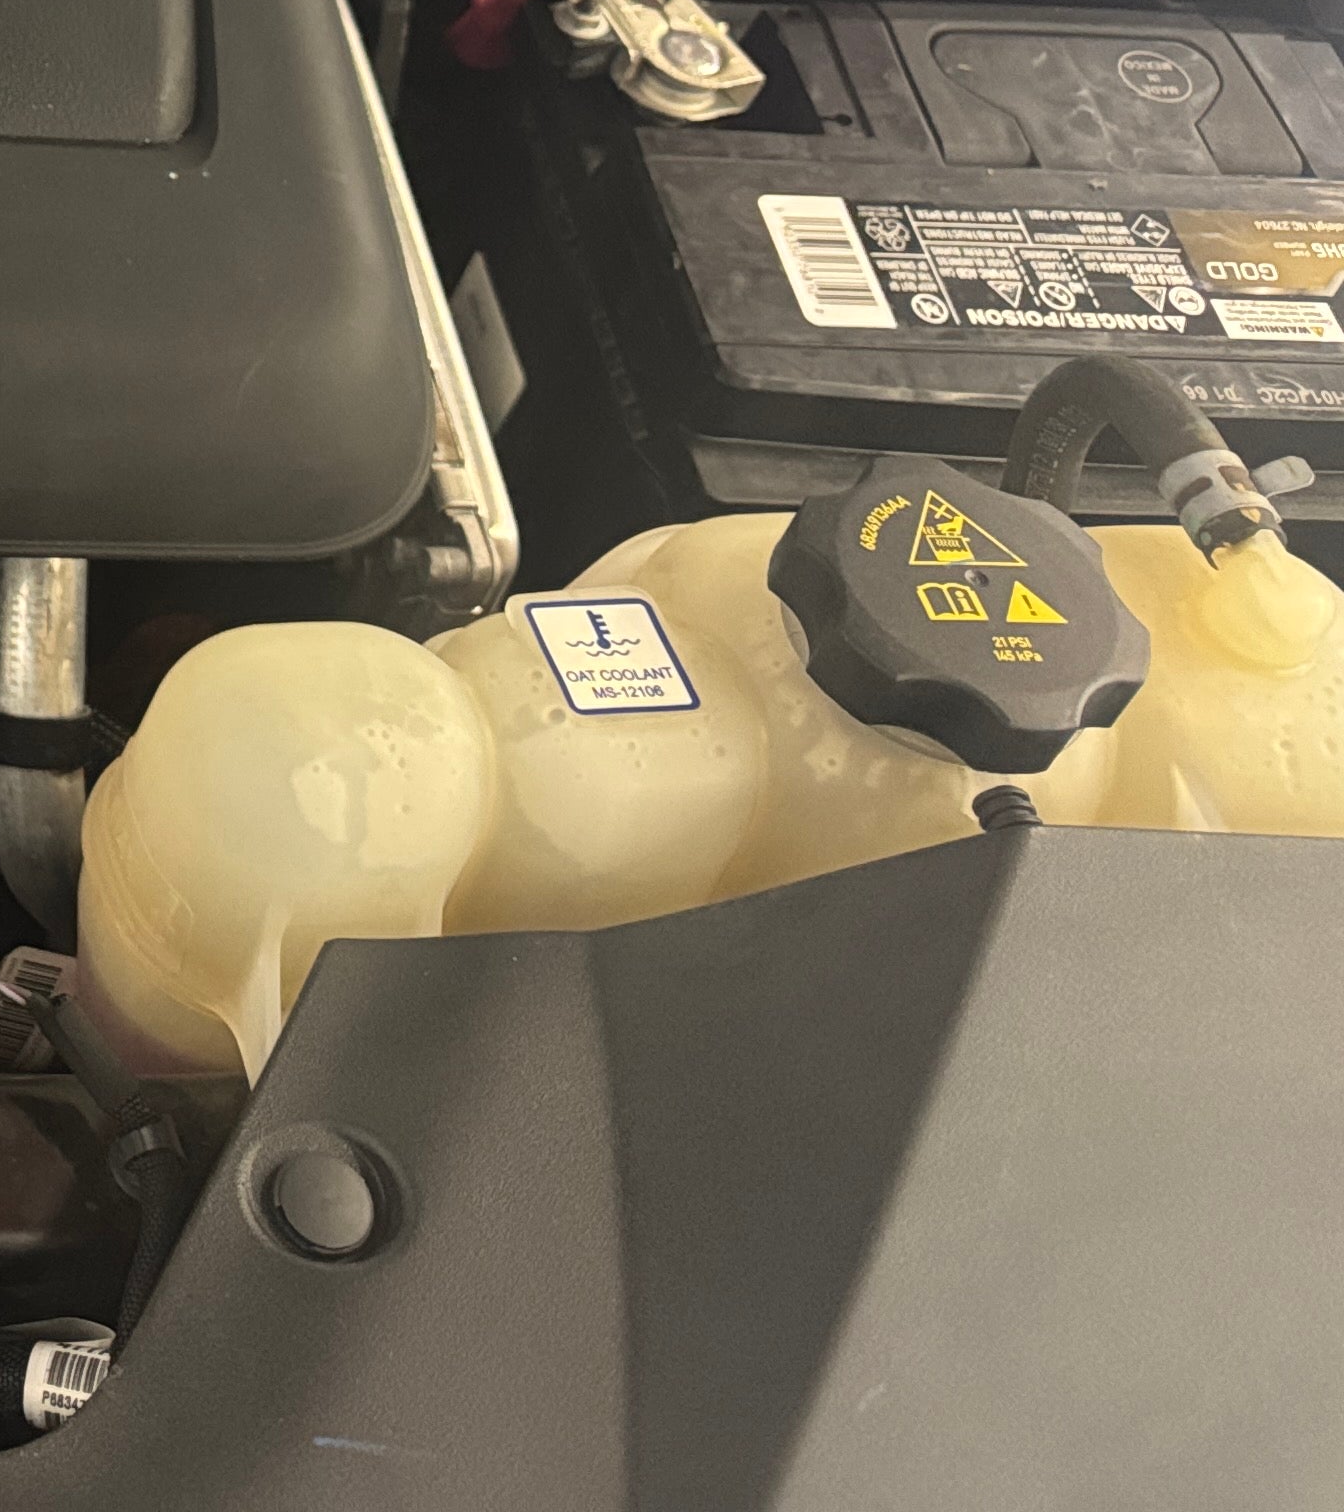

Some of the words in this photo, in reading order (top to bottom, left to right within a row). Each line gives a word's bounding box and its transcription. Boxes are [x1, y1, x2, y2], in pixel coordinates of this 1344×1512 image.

[1206, 262, 1279, 281] GOLD
[966, 308, 1169, 331] DANGER/POISON
[1007, 636, 1032, 648] PSI
[566, 669, 597, 683] OAT
[600, 666, 673, 682] COOLANT
[591, 684, 665, 699] MS-12106
